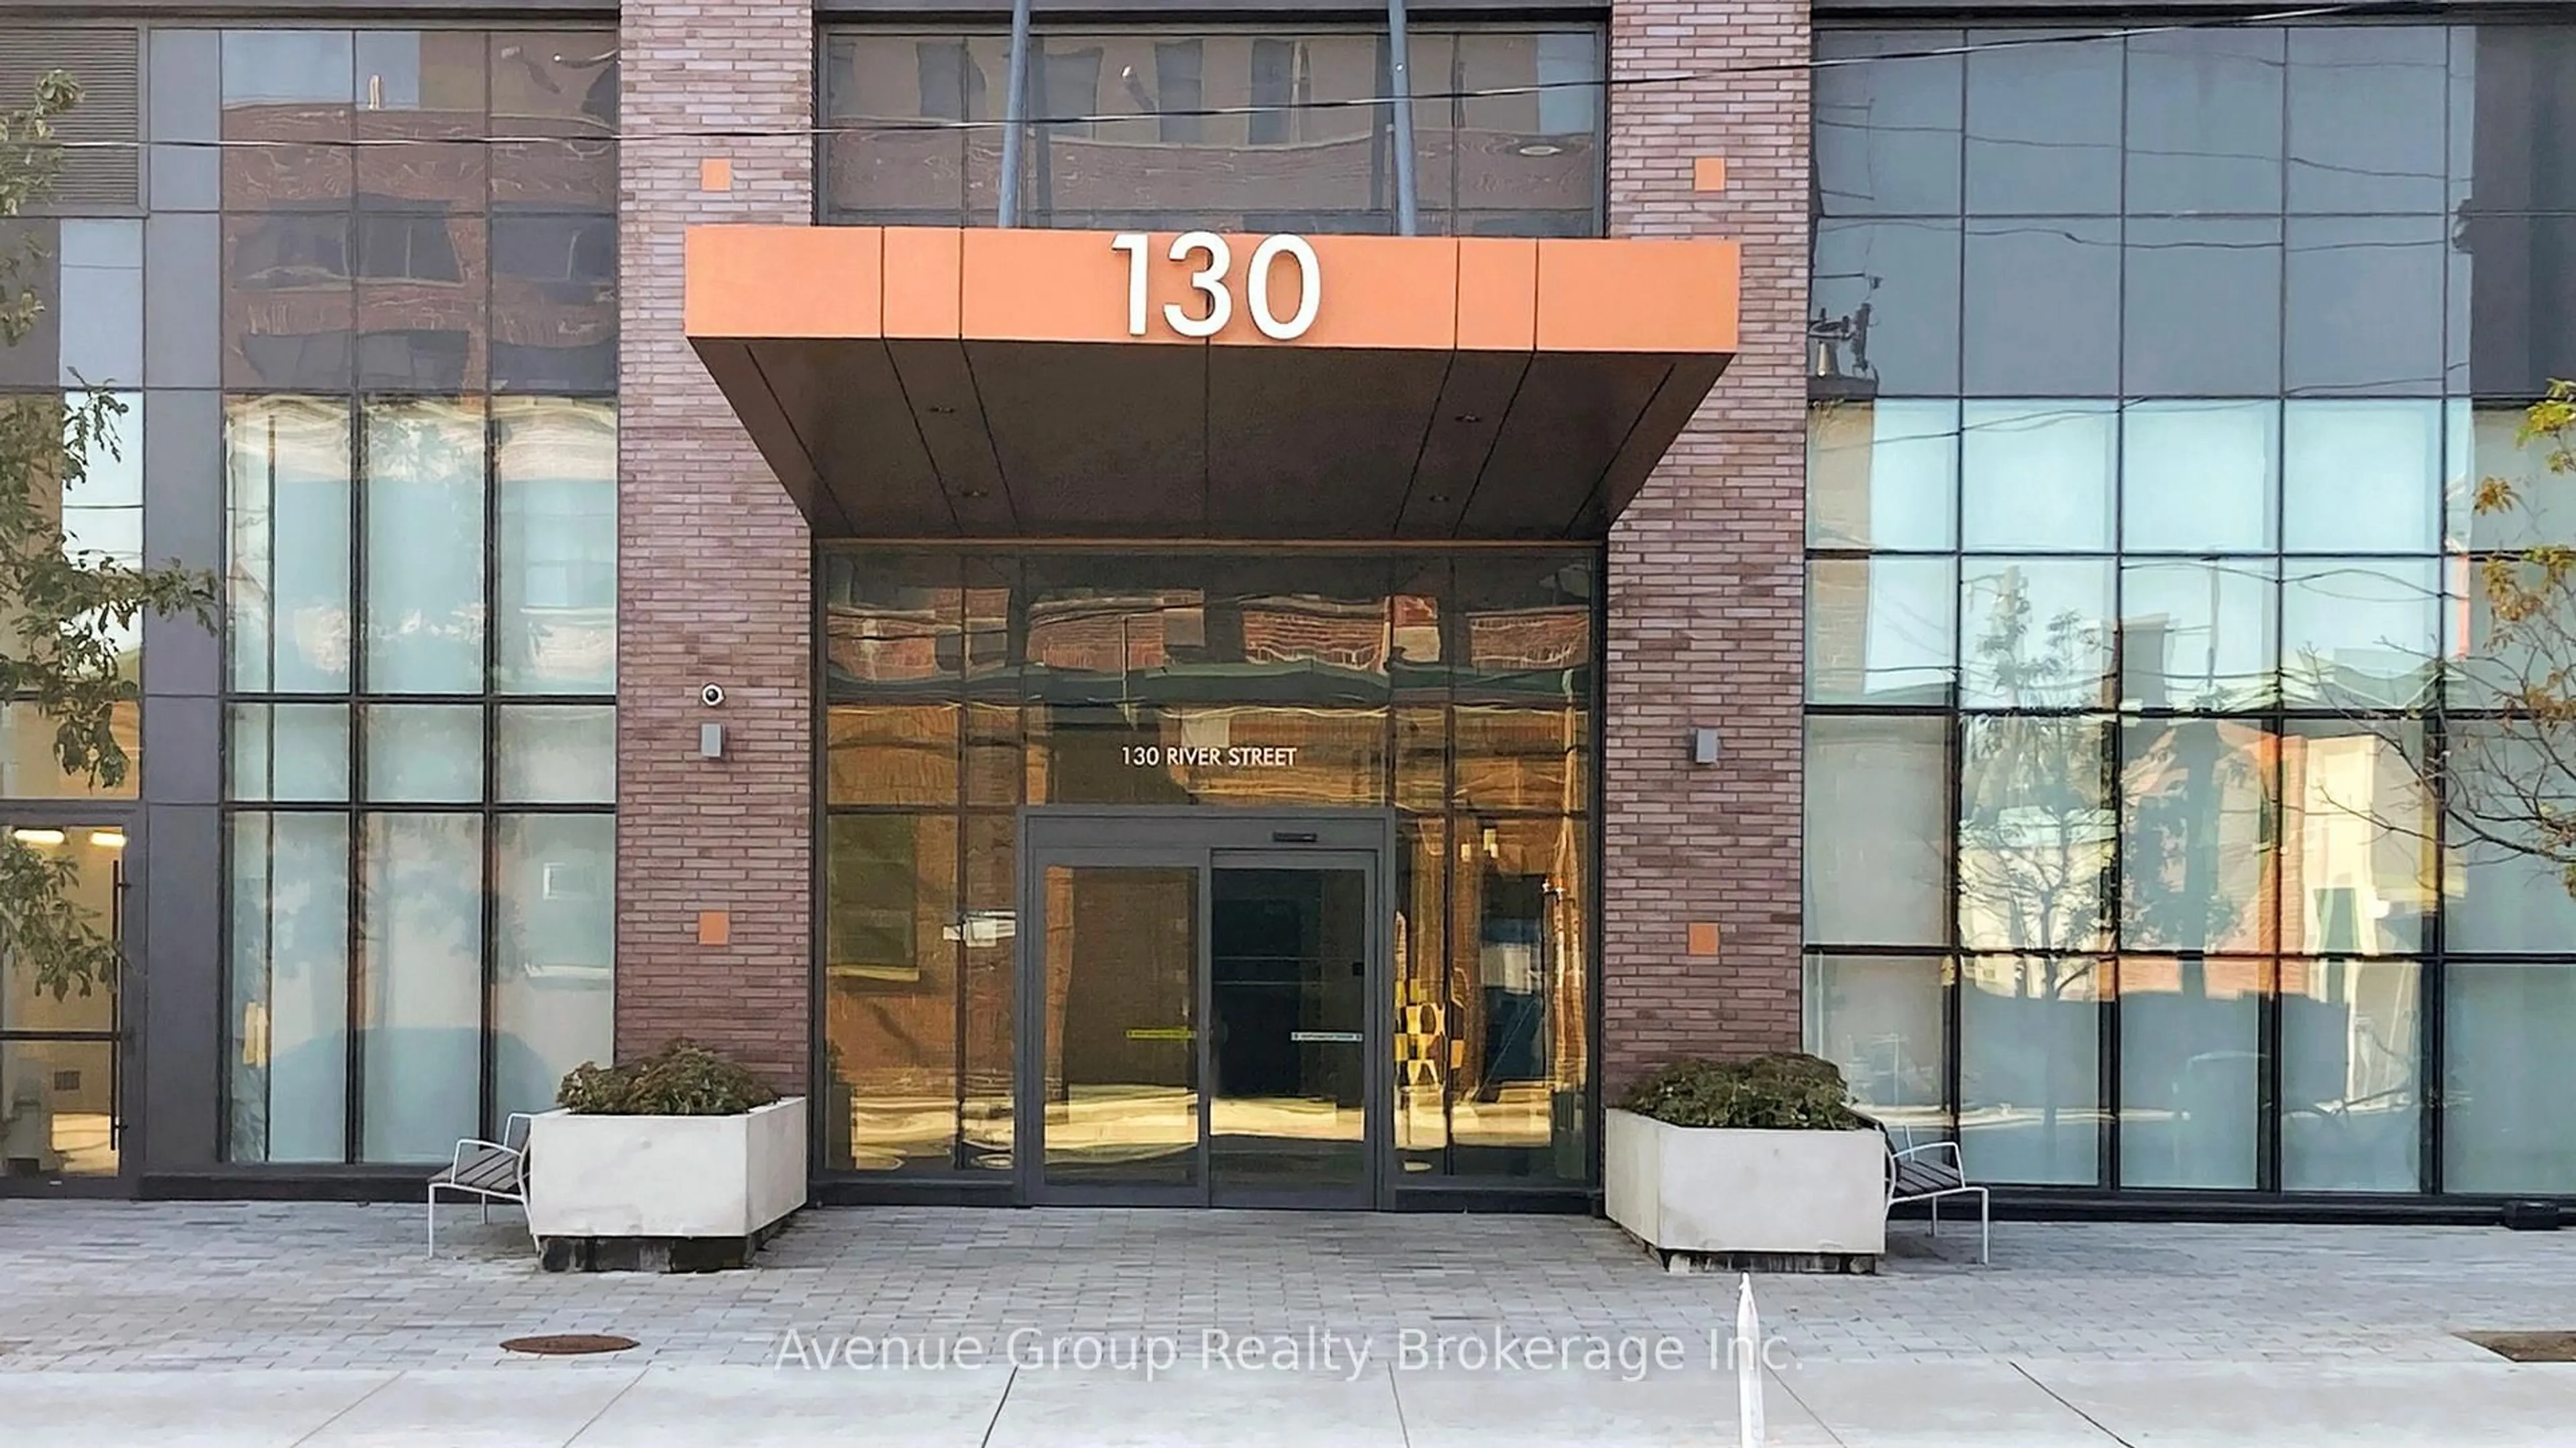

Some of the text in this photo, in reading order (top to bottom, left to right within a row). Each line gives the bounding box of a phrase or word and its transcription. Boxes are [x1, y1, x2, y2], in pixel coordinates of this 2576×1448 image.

[1111, 231, 1322, 340] 130
[1122, 746, 1297, 766] 130 RIVER STREET
